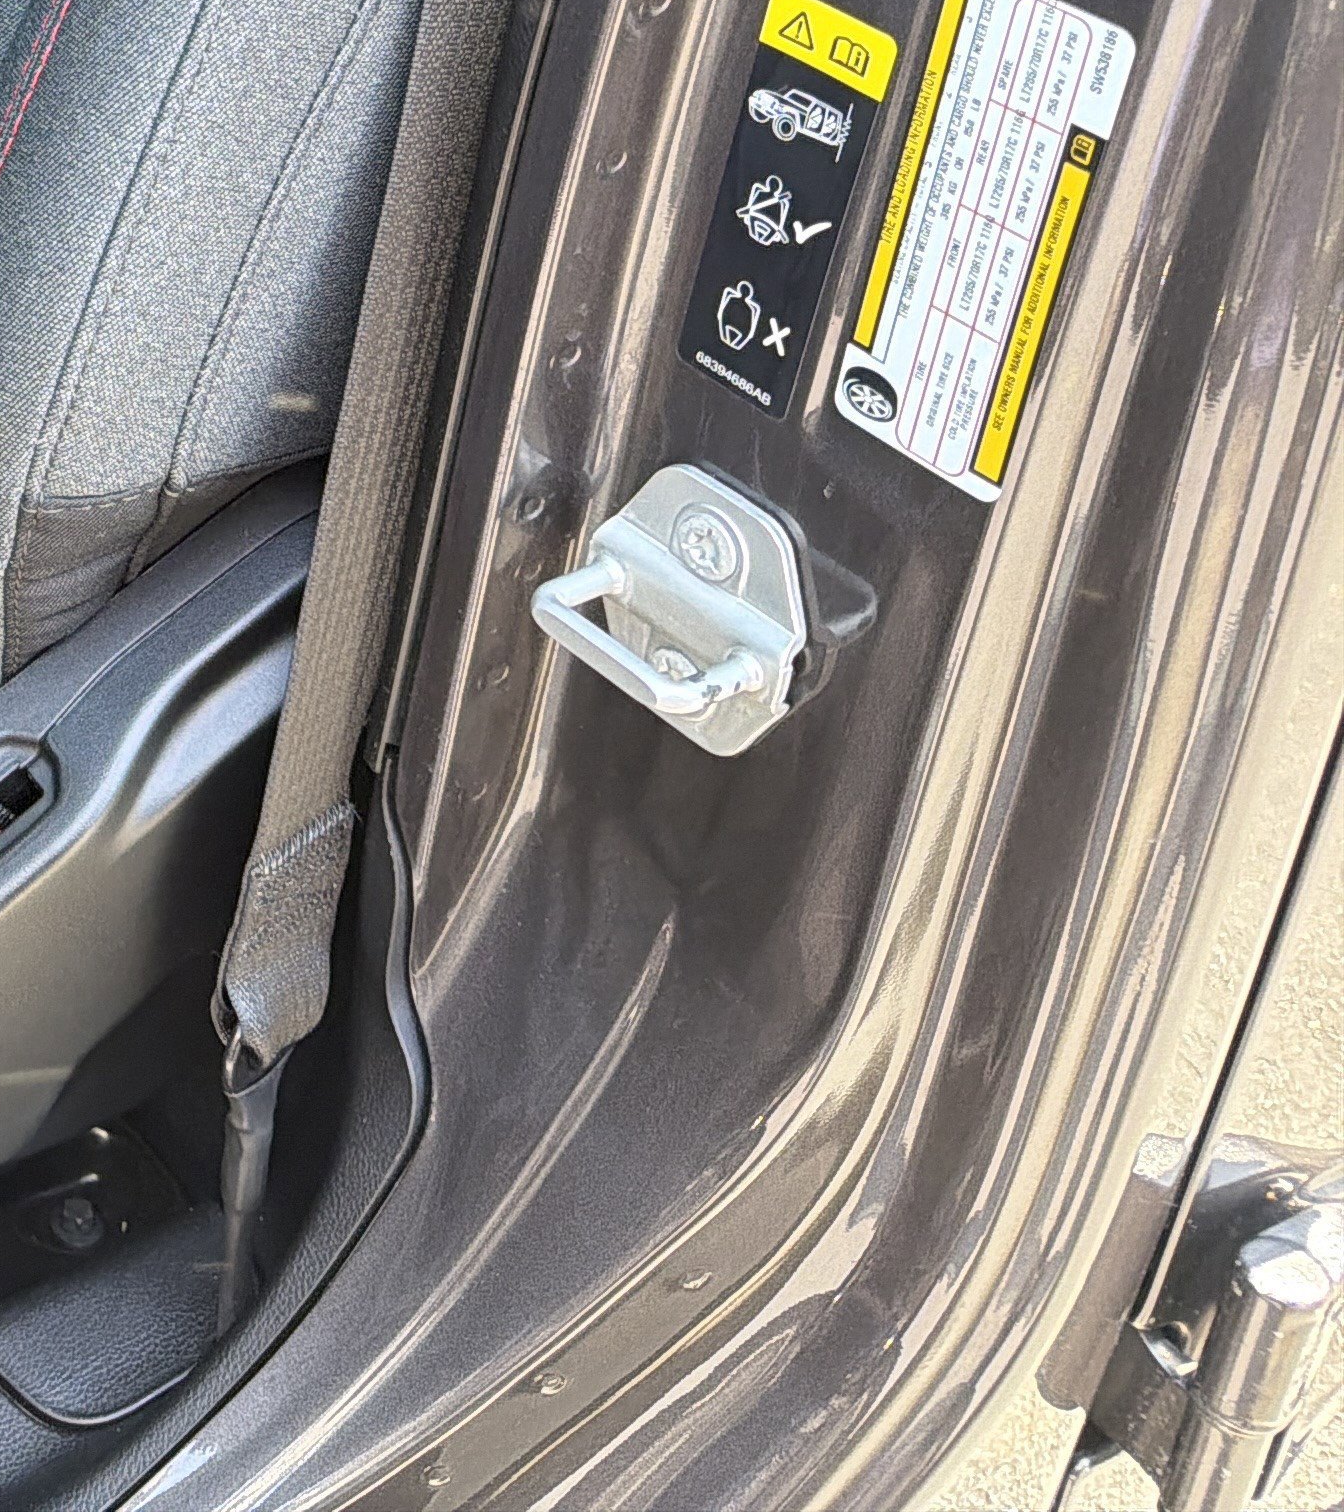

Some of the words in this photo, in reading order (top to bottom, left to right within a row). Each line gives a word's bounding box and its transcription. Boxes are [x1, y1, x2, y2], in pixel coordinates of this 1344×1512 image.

[1064, 30, 1079, 50] PSI
[949, 93, 968, 128] CARGO
[959, 54, 979, 94] SHOULD
[970, 21, 988, 55] NEVER
[997, 58, 1013, 91] SPARE
[1088, 27, 1119, 96] SW538186
[906, 67, 938, 145] INFORMATION
[975, 138, 990, 166] REAR
[1032, 139, 1046, 160] PSI
[892, 143, 917, 195] LOADING
[887, 193, 902, 219] AND
[879, 218, 896, 245] TIRE
[1042, 194, 1070, 261] INFORMATION
[945, 237, 962, 269] FRONT
[1001, 245, 1015, 265] PSI
[1025, 258, 1050, 315] ADDITIONAL
[1019, 314, 1033, 336] FOR
[1008, 334, 1027, 375] MANUAL
[914, 359, 927, 381] TIRE
[991, 411, 1004, 432] SEE
